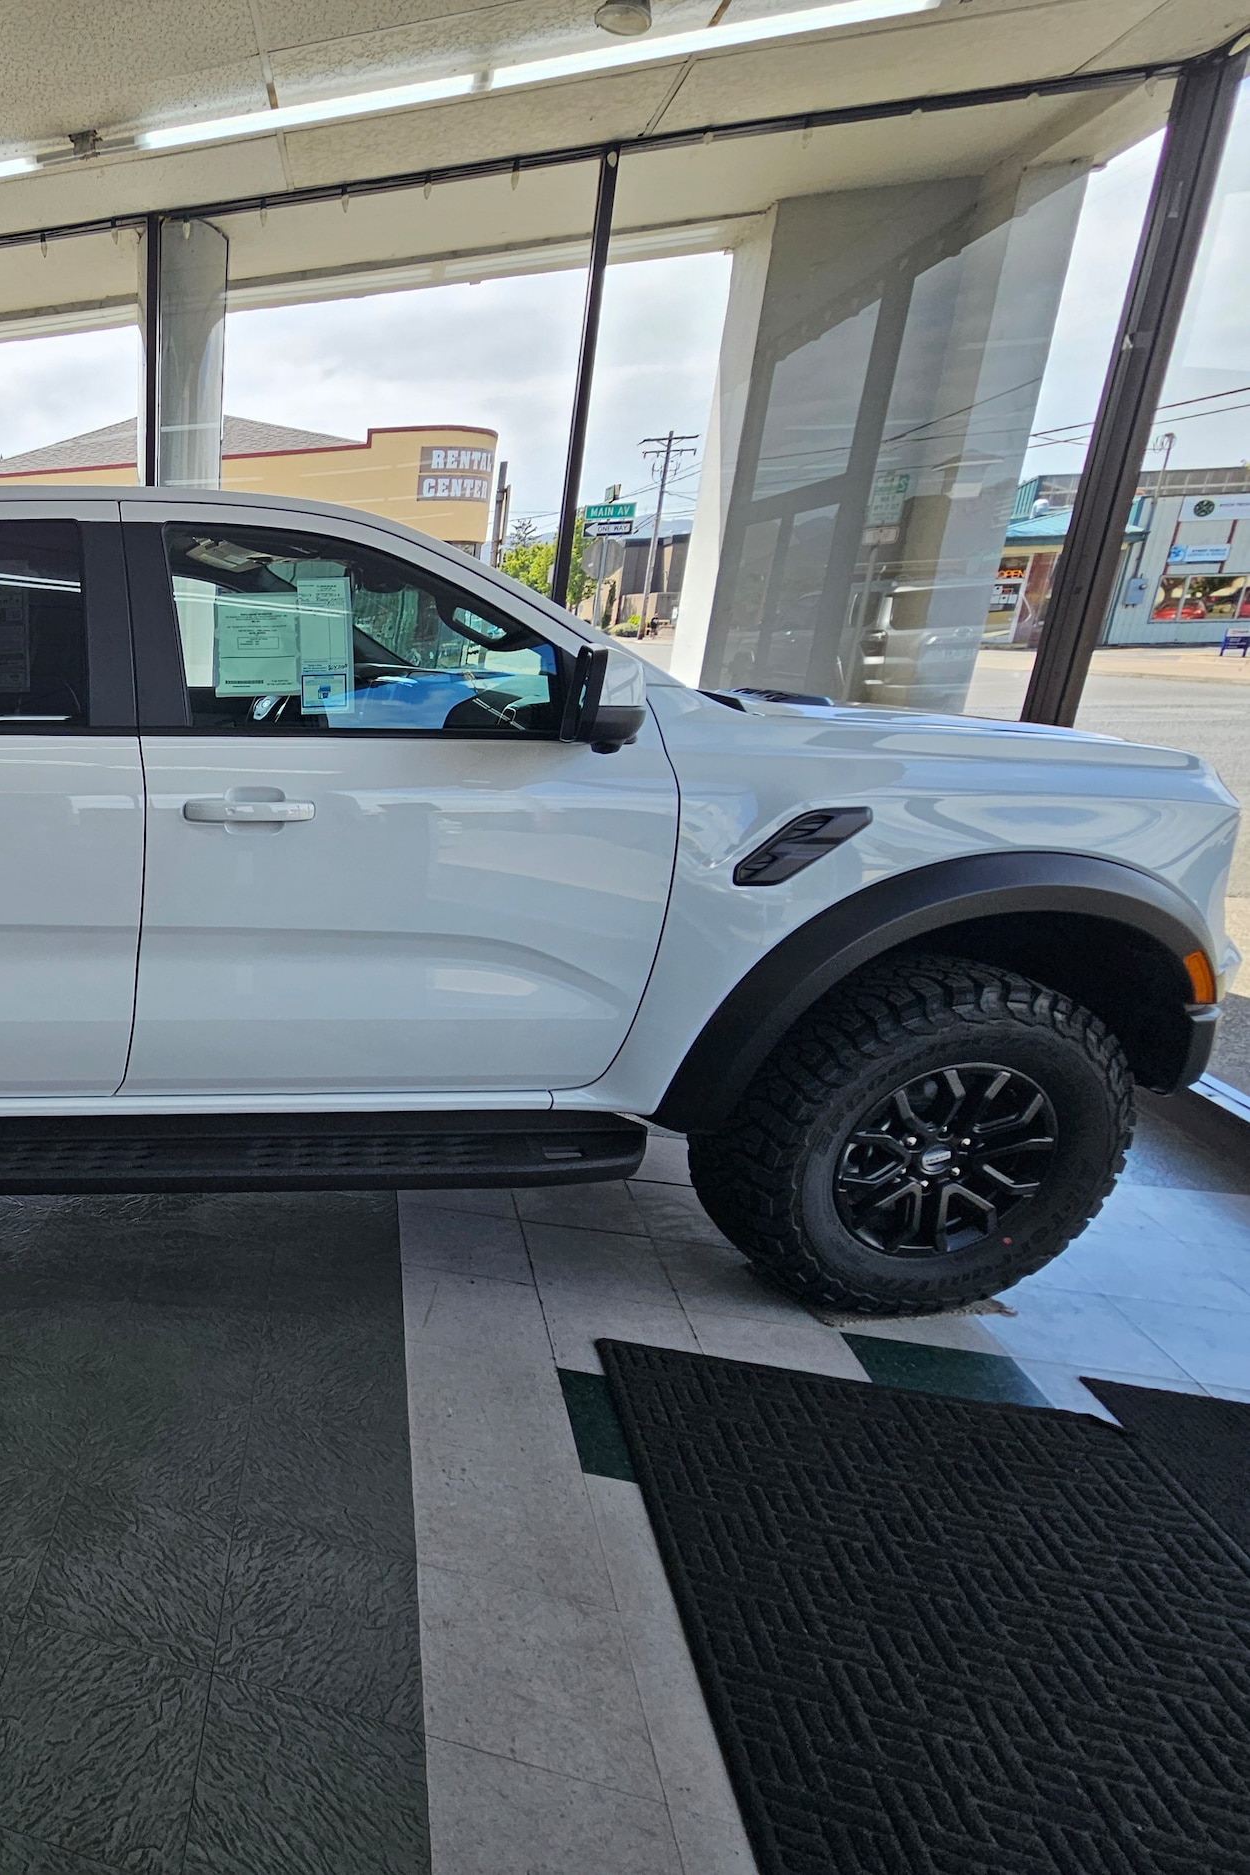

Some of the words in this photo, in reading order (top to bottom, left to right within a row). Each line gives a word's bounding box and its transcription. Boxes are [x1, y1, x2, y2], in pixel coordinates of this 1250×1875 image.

[430, 449, 493, 473] RENTAL
[422, 477, 488, 499] CENTER
[590, 506, 614, 517] MAIN
[617, 505, 631, 516] AV
[597, 525, 612, 533] ONE
[613, 524, 628, 532] WAY
[997, 570, 1025, 579] OPEN
